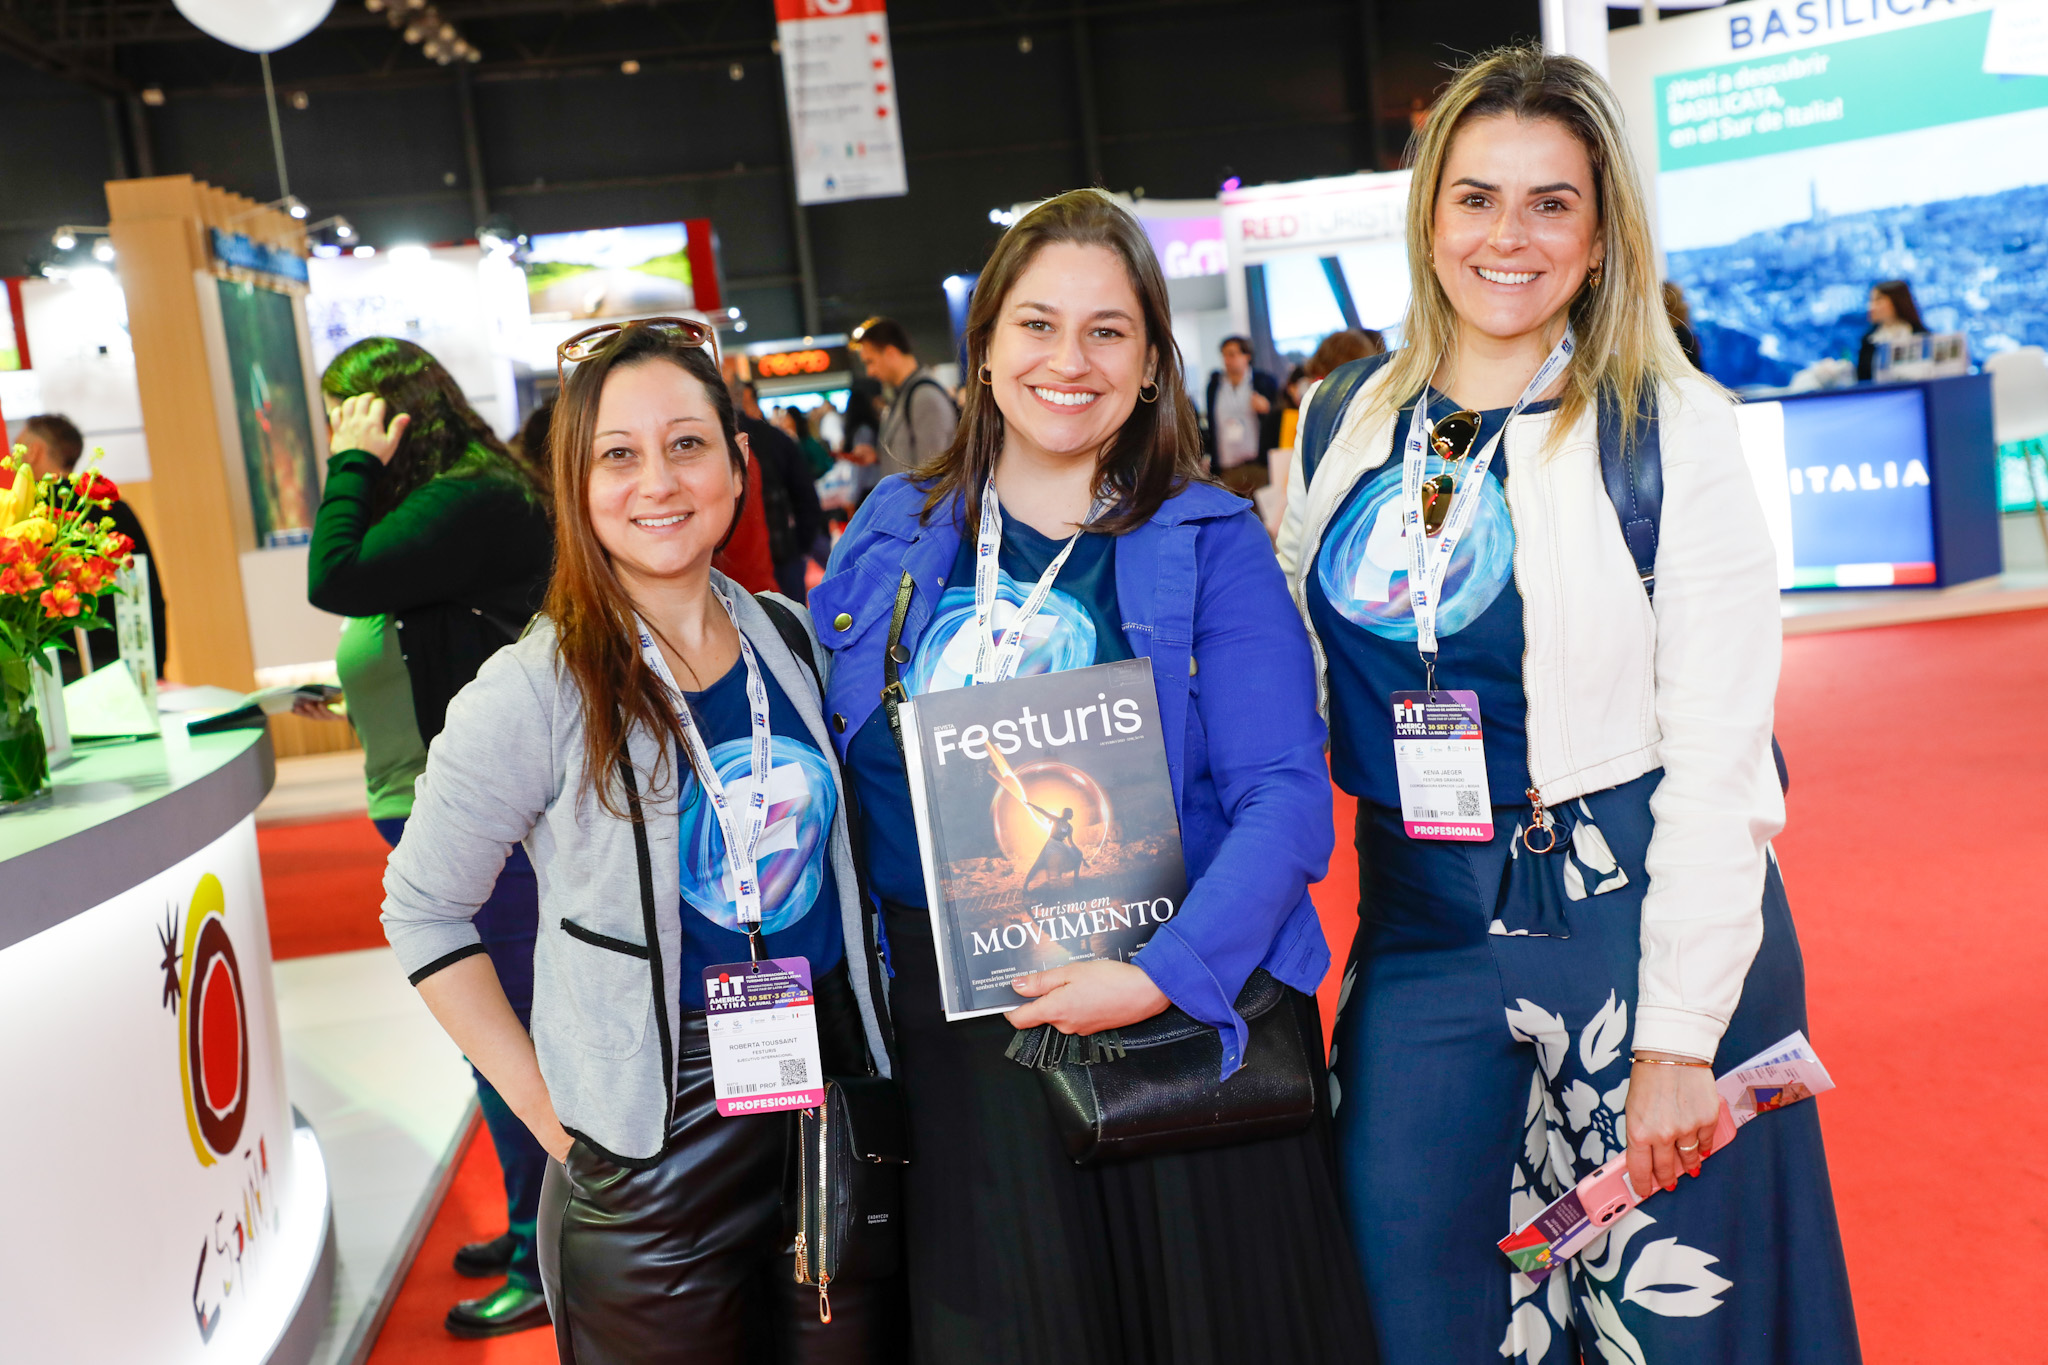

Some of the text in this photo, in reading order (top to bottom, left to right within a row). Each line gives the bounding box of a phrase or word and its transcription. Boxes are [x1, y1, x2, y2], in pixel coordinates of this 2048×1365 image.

[1729, 0, 1954, 50] BASILI
[1669, 127, 1697, 148] en
[1718, 116, 1754, 140] Sur
[1754, 109, 1783, 133] de
[1164, 238, 1227, 279] GO
[1789, 459, 1930, 494] ITALIA
[933, 692, 1143, 766] Festuris
[1413, 825, 1483, 836] PROFESIONAL
[1031, 895, 1111, 920] Turismo em
[971, 896, 1175, 957] MOVIMENTO
[971, 974, 1004, 985] Empresários
[1004, 970, 1028, 979] investem
[975, 982, 994, 991] sonhos
[709, 994, 746, 1004] AMERICA
[709, 1001, 746, 1010] LATINA
[729, 1037, 797, 1050] ROBERTA TOUSSAINT
[727, 1093, 812, 1112] PROFESIONAL
